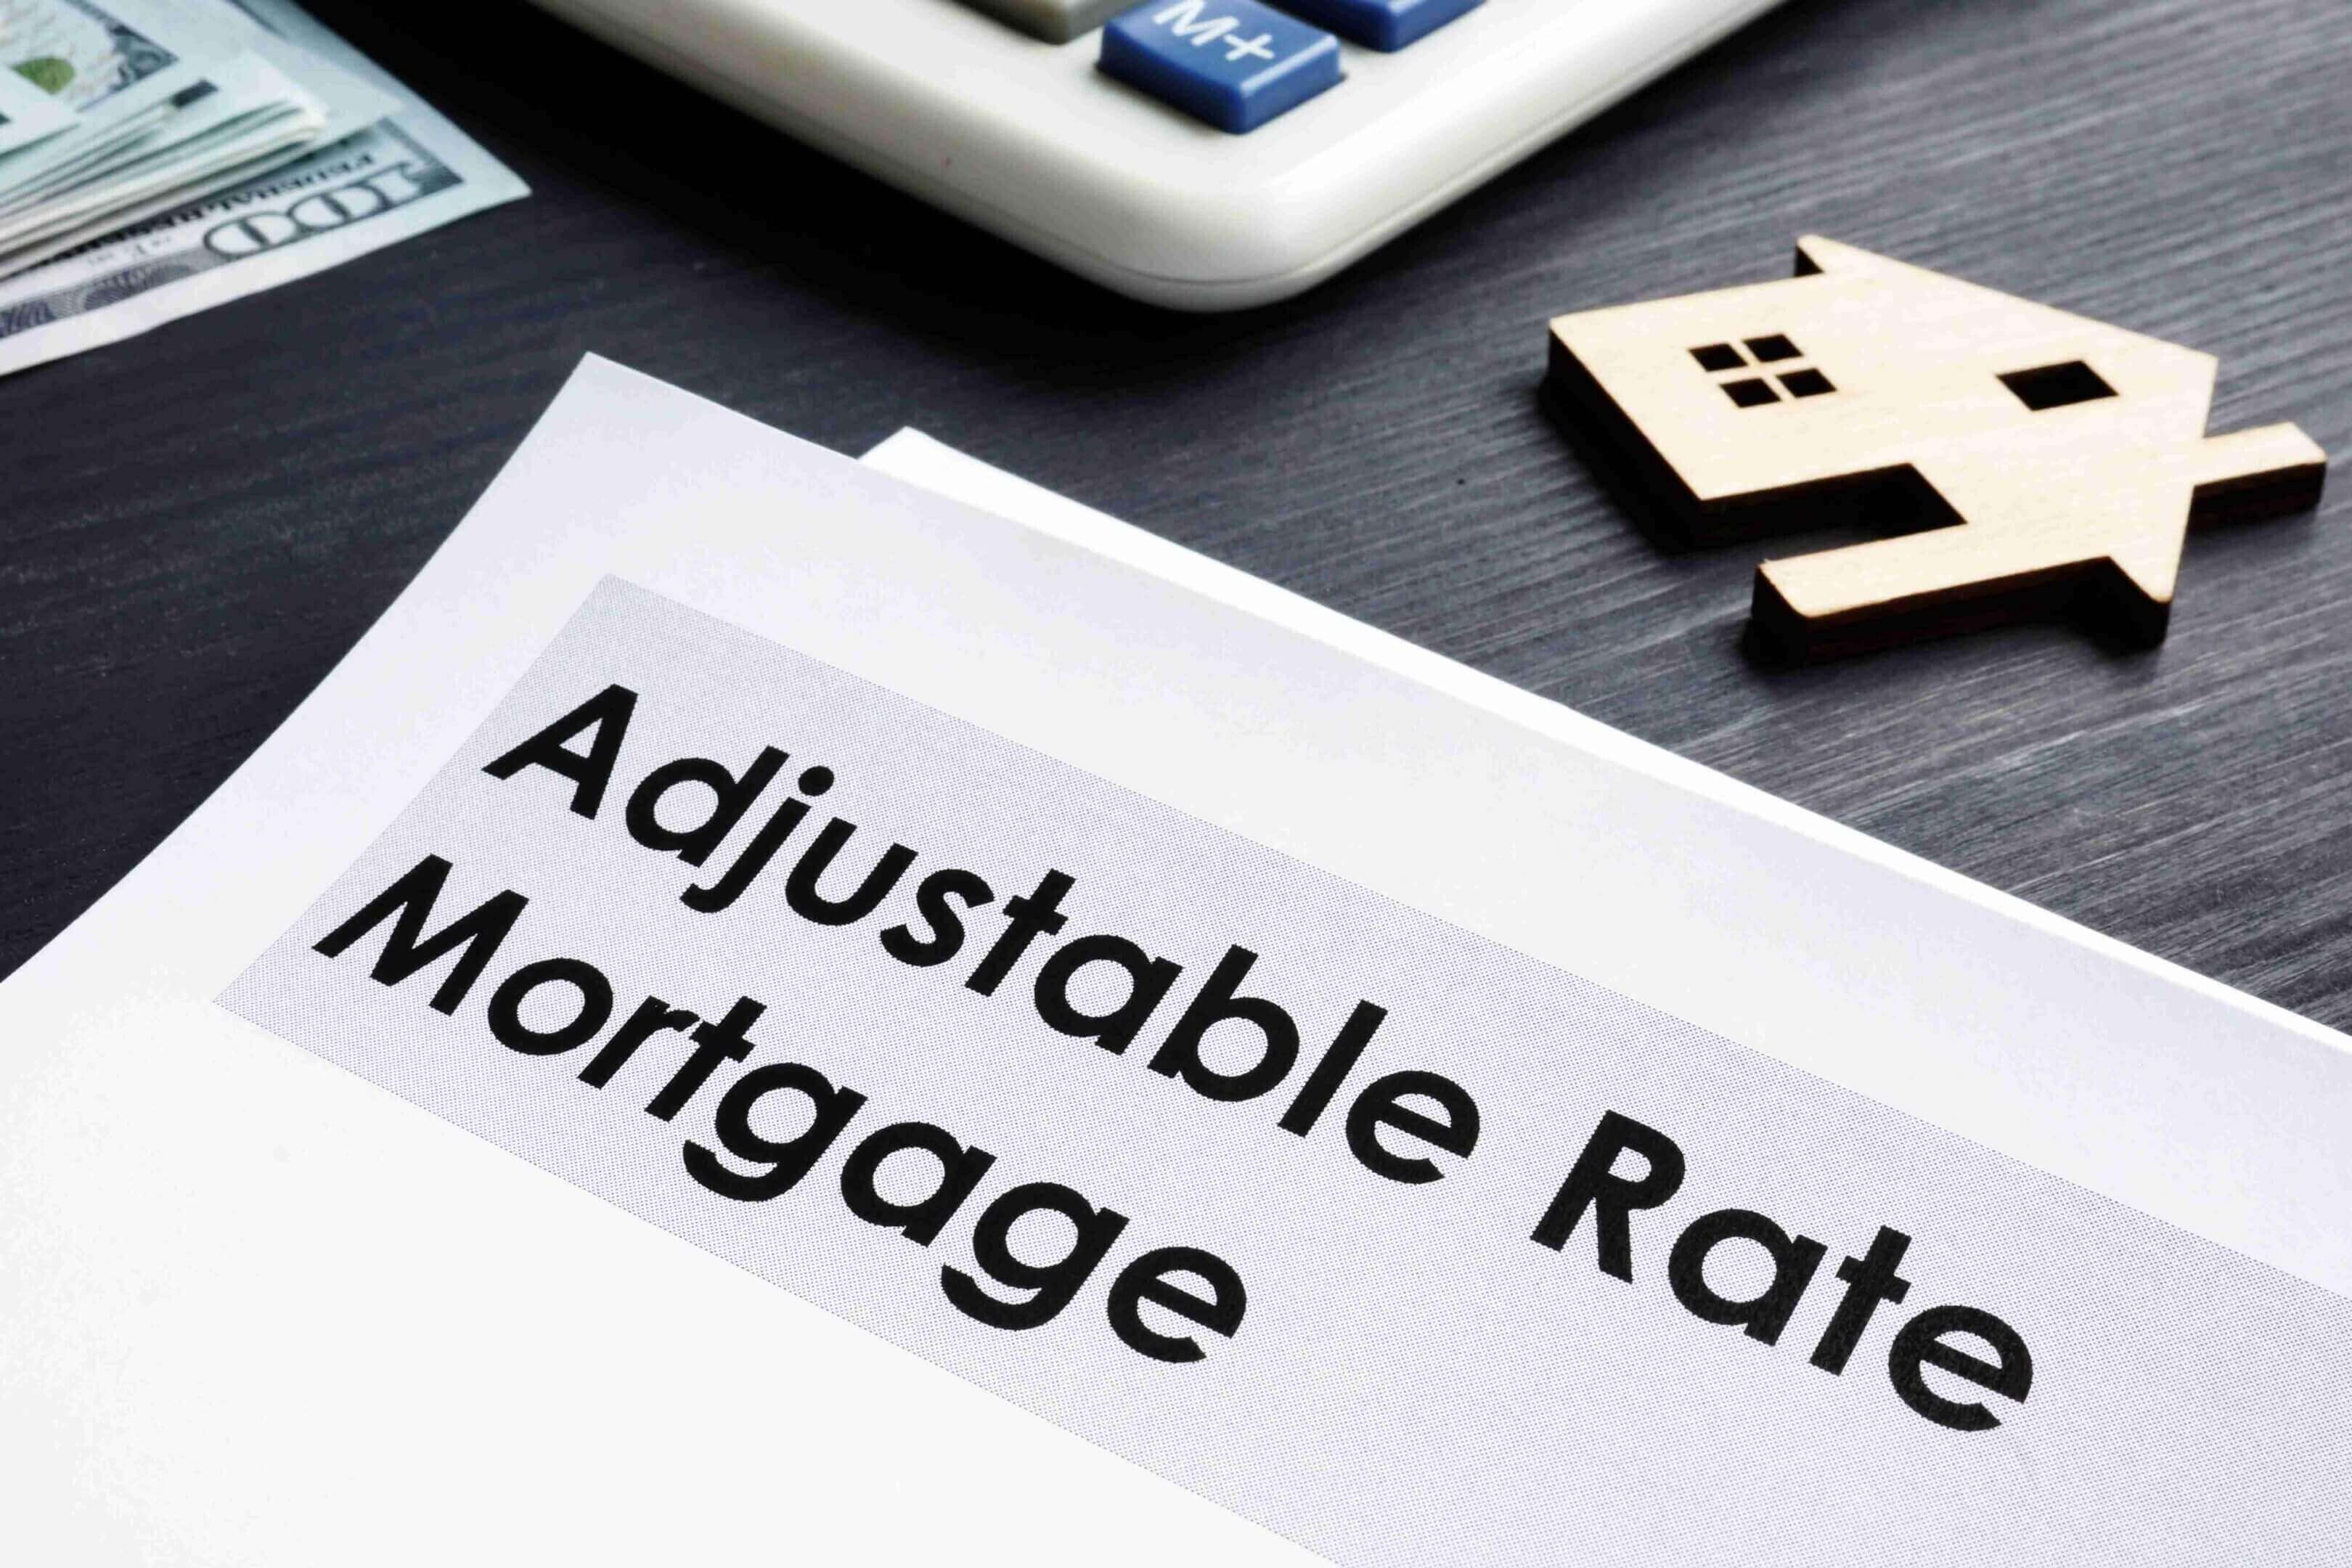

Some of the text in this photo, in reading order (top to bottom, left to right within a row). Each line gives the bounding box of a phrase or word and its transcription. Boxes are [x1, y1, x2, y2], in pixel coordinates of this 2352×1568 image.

[1153, 0, 1275, 61] M+
[203, 161, 422, 263] 100
[311, 854, 1247, 1364] Mortgage
[481, 683, 2034, 1432] Adjustable Rate
